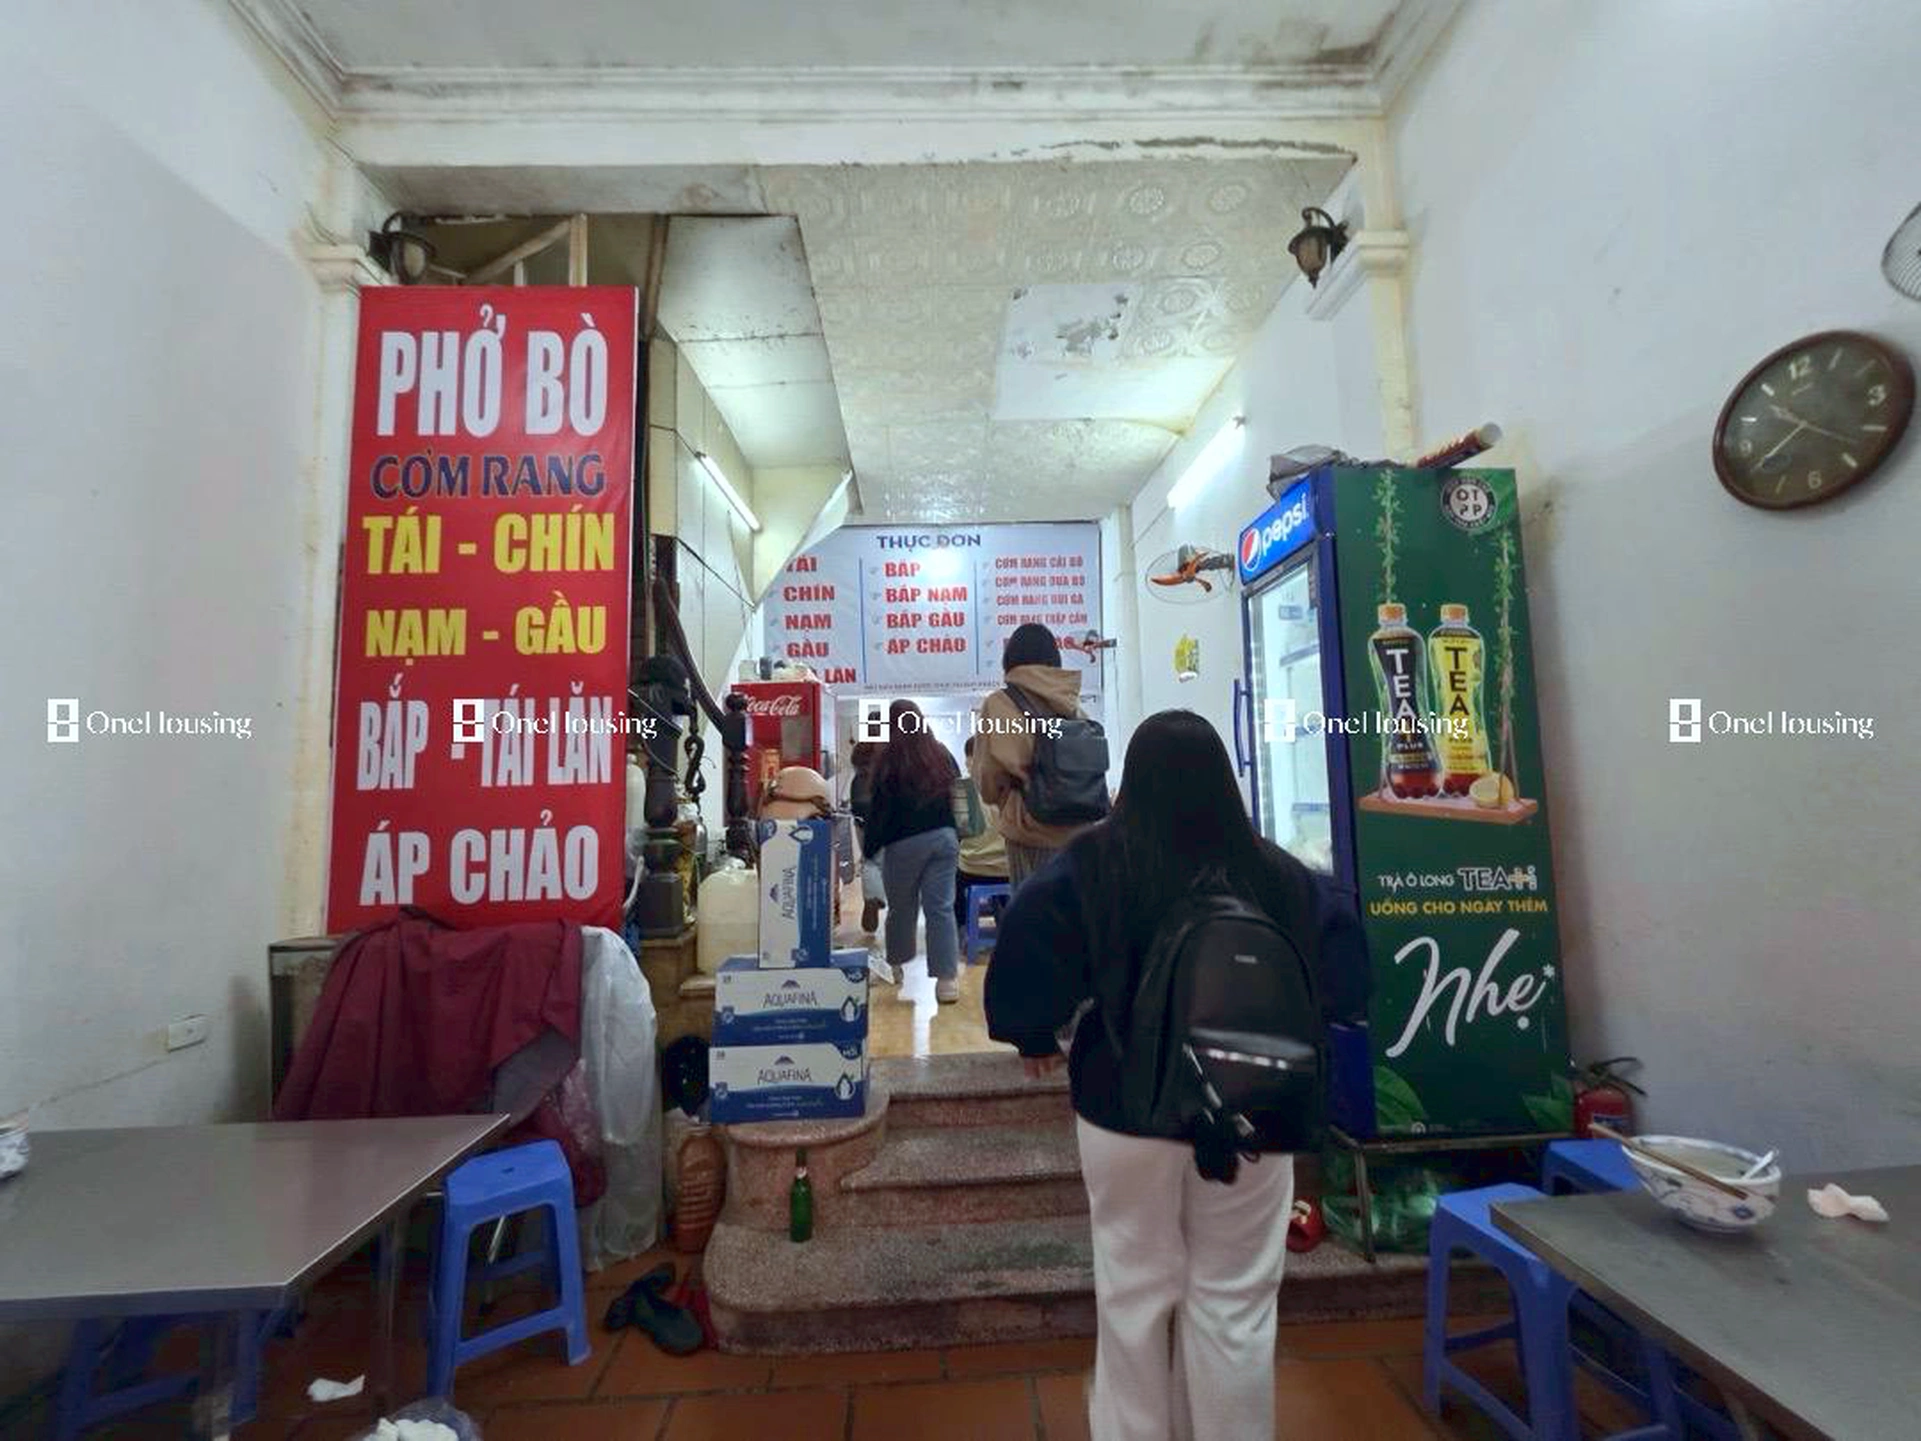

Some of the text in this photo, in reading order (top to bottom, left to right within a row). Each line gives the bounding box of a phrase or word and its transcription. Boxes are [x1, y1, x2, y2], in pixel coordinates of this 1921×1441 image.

[377, 304, 608, 437] PHỞ BÒ
[370, 448, 605, 499] CƠM RANG
[362, 506, 441, 574] TÁI
[494, 504, 615, 574] CHÍN
[877, 534, 930, 552] THỰC
[1263, 493, 1307, 556] pepsi
[783, 584, 835, 601] CHÍN
[365, 609, 466, 666] NẠM
[515, 590, 606, 654] GẦU
[786, 614, 831, 632] NẠM
[1386, 649, 1416, 720] TEA
[1445, 647, 1469, 715] TEA
[356, 673, 429, 790] BẮP
[547, 681, 613, 785] LĂN
[359, 809, 599, 906] ÁP CHẢO
[1420, 873, 1455, 887] LONG
[1370, 897, 1548, 915] UỐNG CHO NGAY THÊM
[763, 991, 818, 1009] AQUAFINA
[757, 1067, 813, 1085] AQUAFINA
